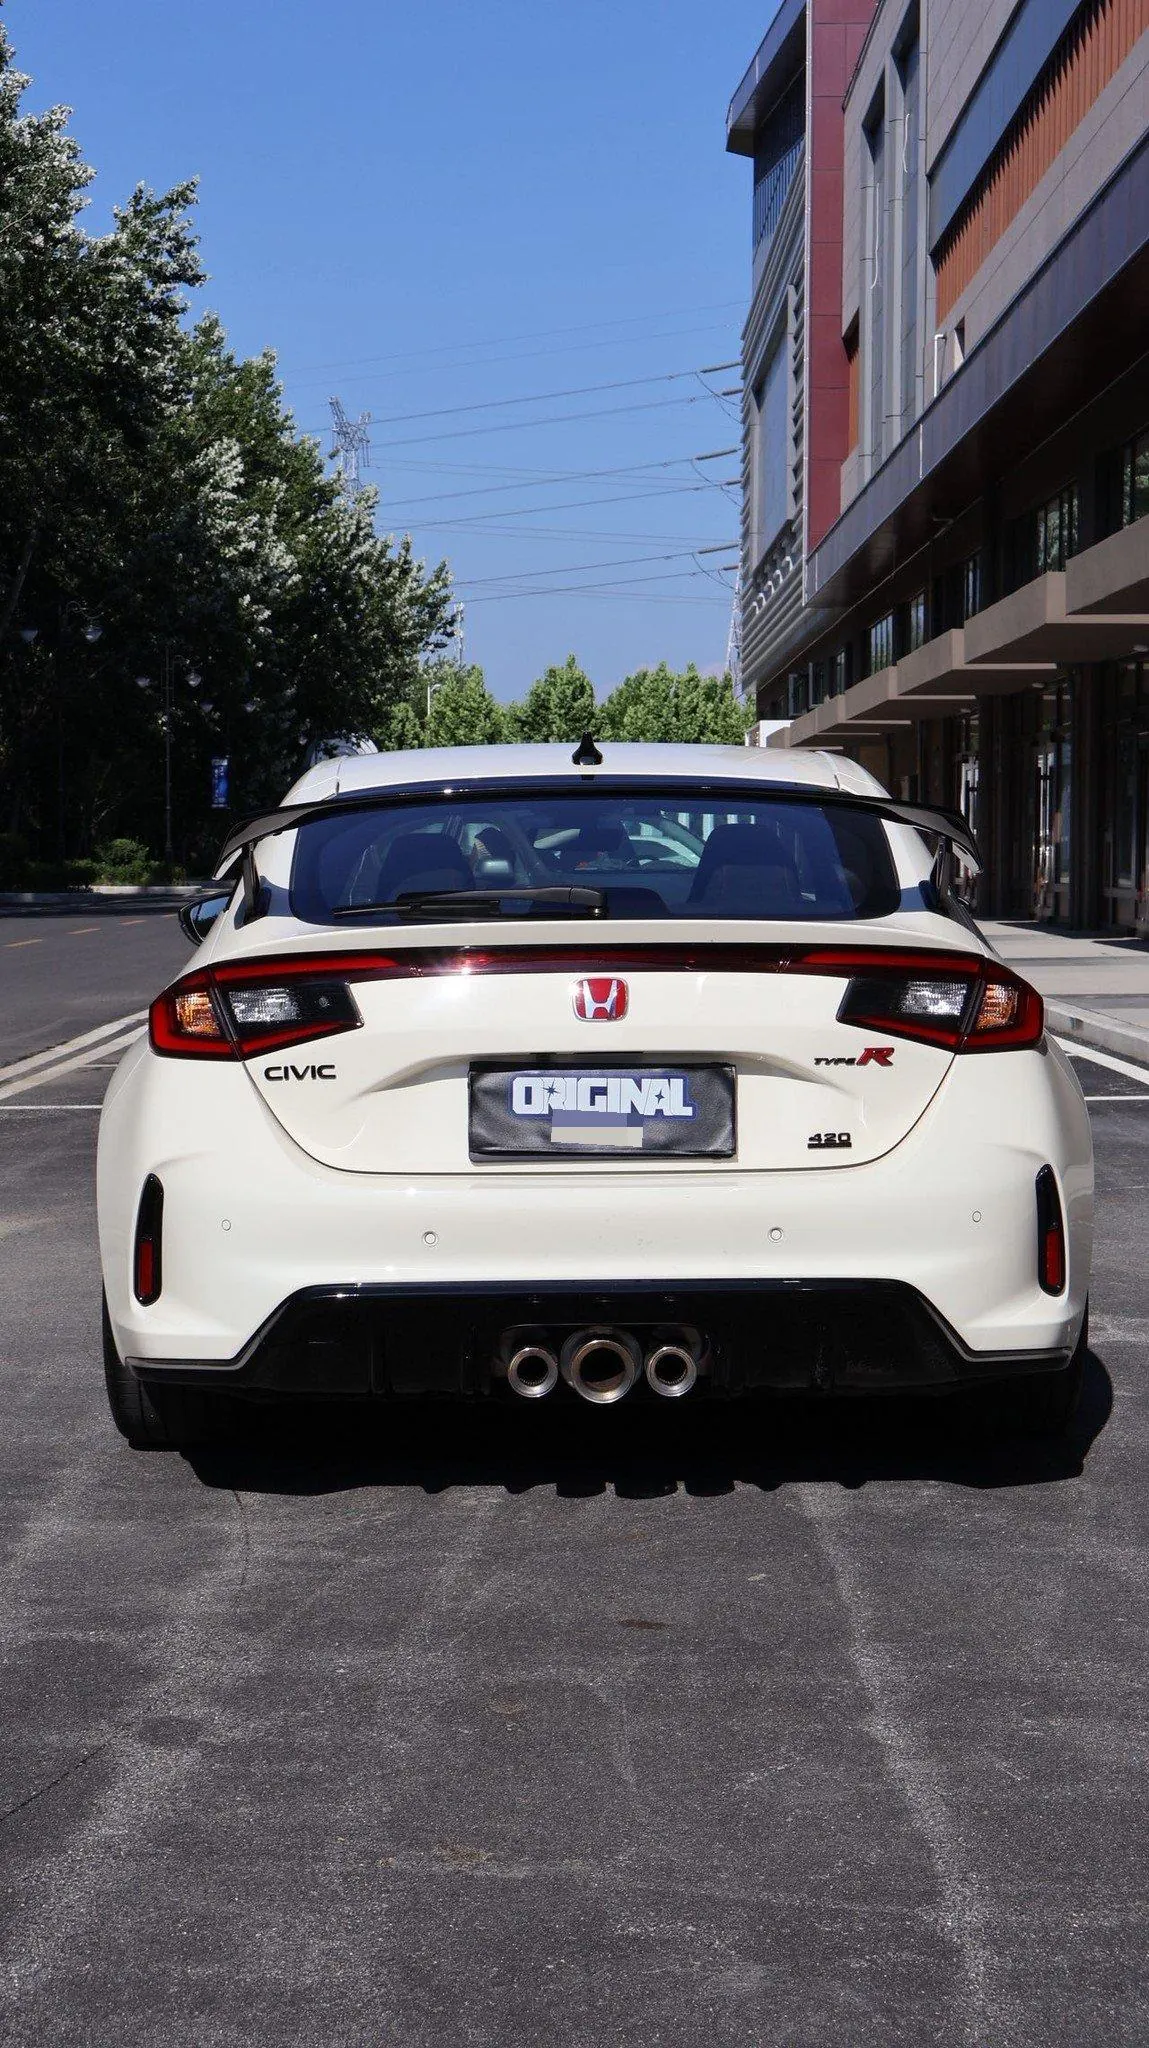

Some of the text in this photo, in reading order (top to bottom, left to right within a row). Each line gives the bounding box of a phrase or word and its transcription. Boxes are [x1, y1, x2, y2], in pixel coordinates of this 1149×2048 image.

[814, 1047, 895, 1066] TYPE R
[264, 1065, 337, 1081] CIVIC
[512, 1077, 693, 1116] ORIGINAL
[808, 1132, 851, 1142] 420
